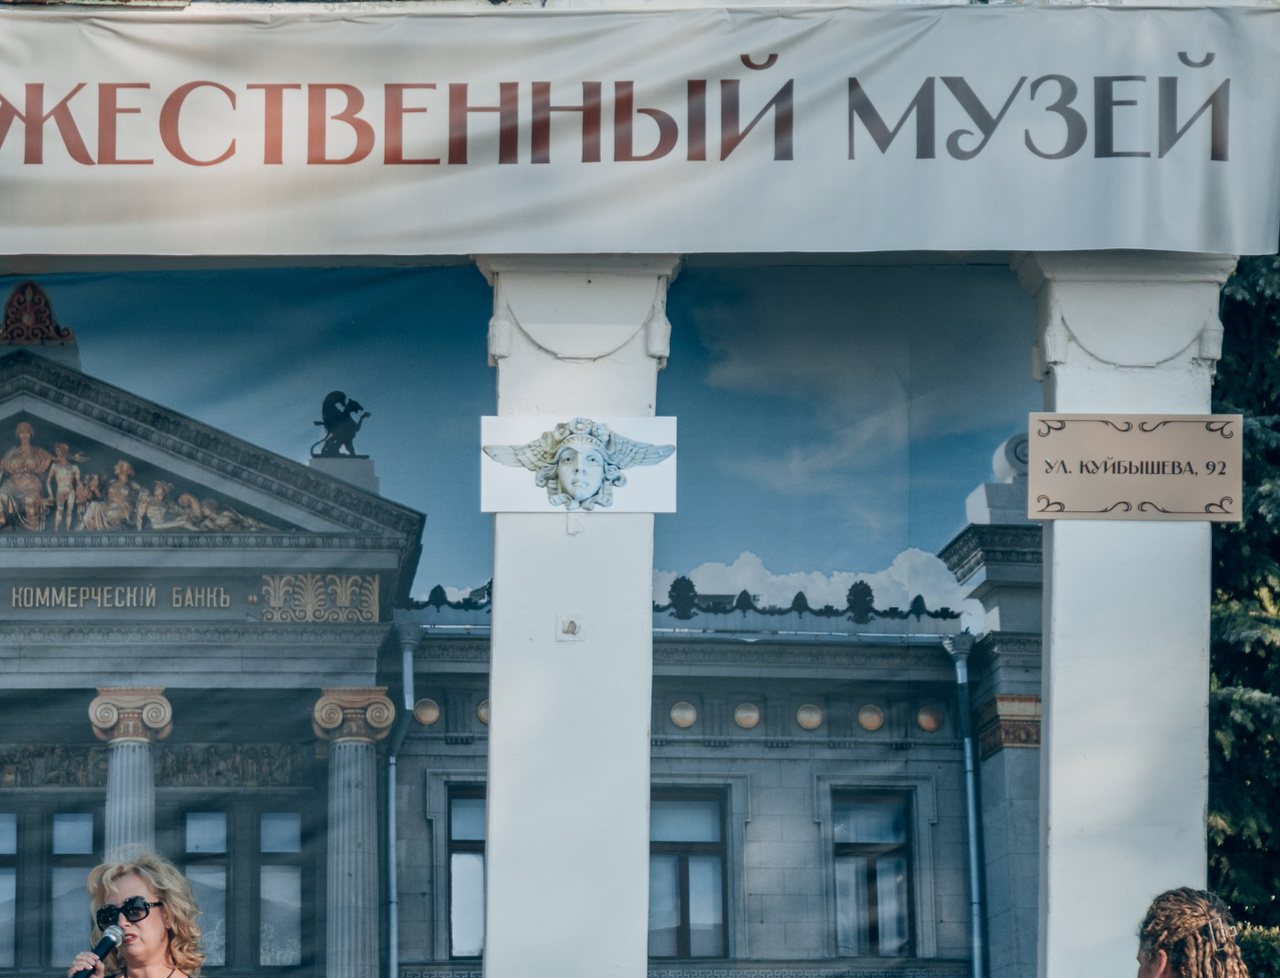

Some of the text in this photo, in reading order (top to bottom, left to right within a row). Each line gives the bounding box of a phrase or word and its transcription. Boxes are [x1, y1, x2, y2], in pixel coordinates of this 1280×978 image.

[847, 51, 1231, 162] МУЗЕЙ
[1044, 456, 1227, 477] УЛ. КУЙБЫШЕВА, 92
[172, 586, 230, 608] БАНКЪ
